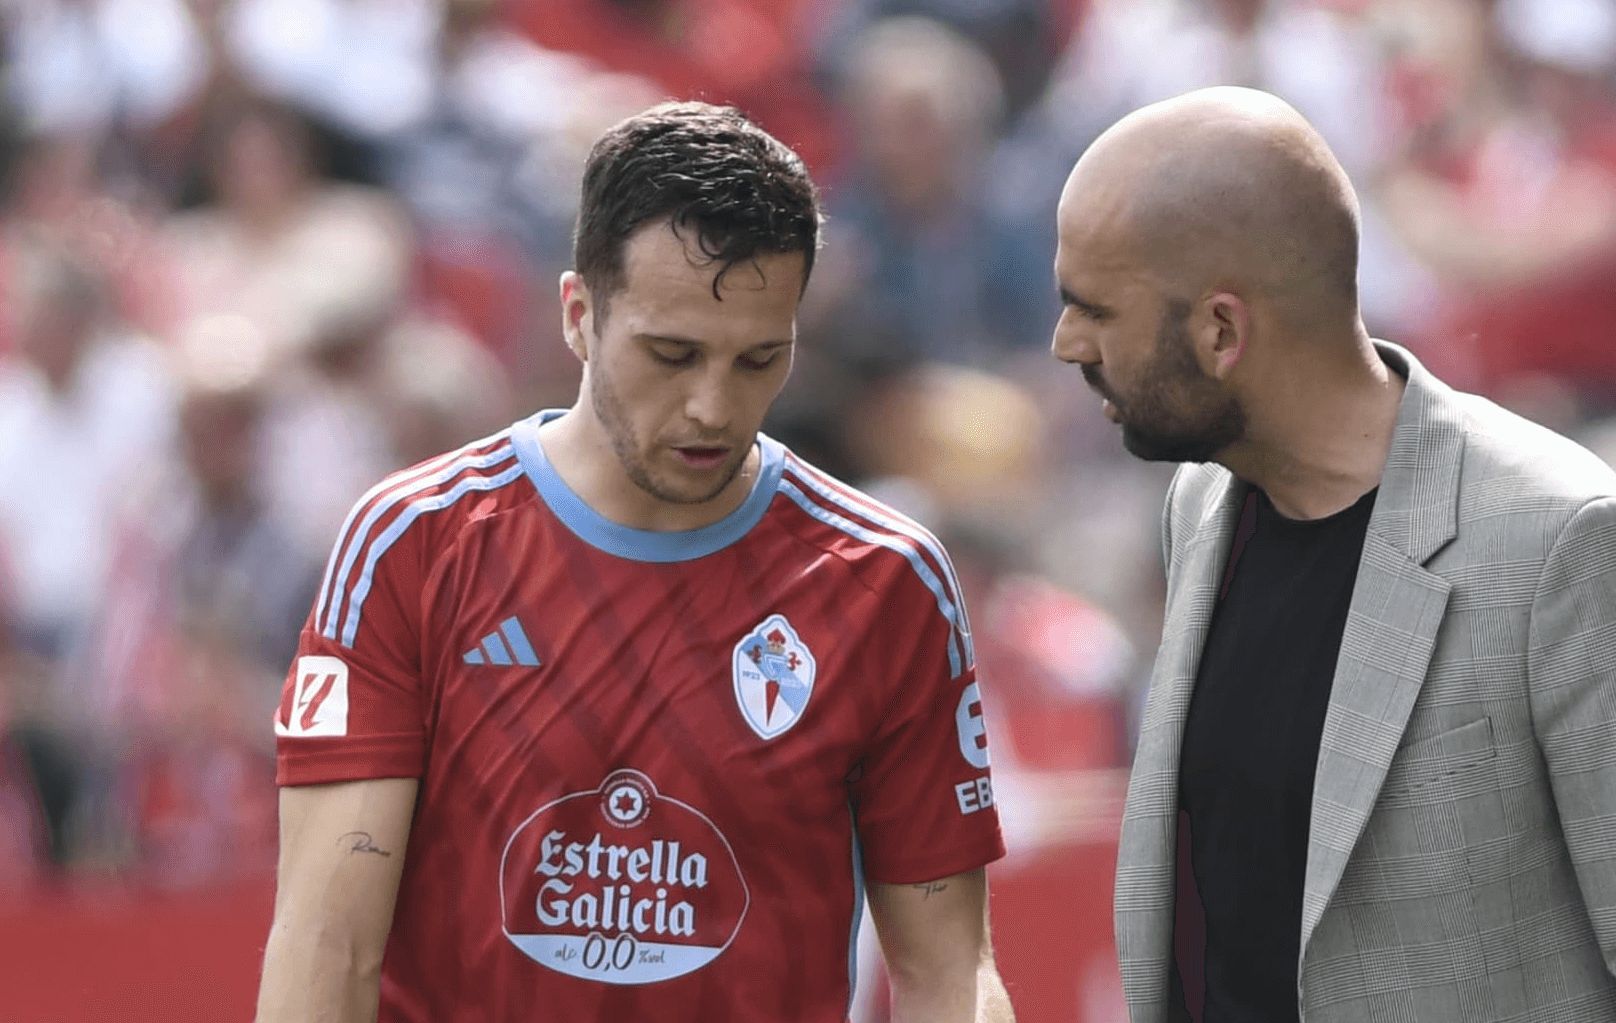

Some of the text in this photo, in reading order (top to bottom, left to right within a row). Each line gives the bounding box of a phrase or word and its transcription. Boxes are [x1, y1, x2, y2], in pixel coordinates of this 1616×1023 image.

[534, 830, 708, 888] Estrella
[536, 878, 696, 937] Galicia
[582, 934, 636, 971] 0,0
